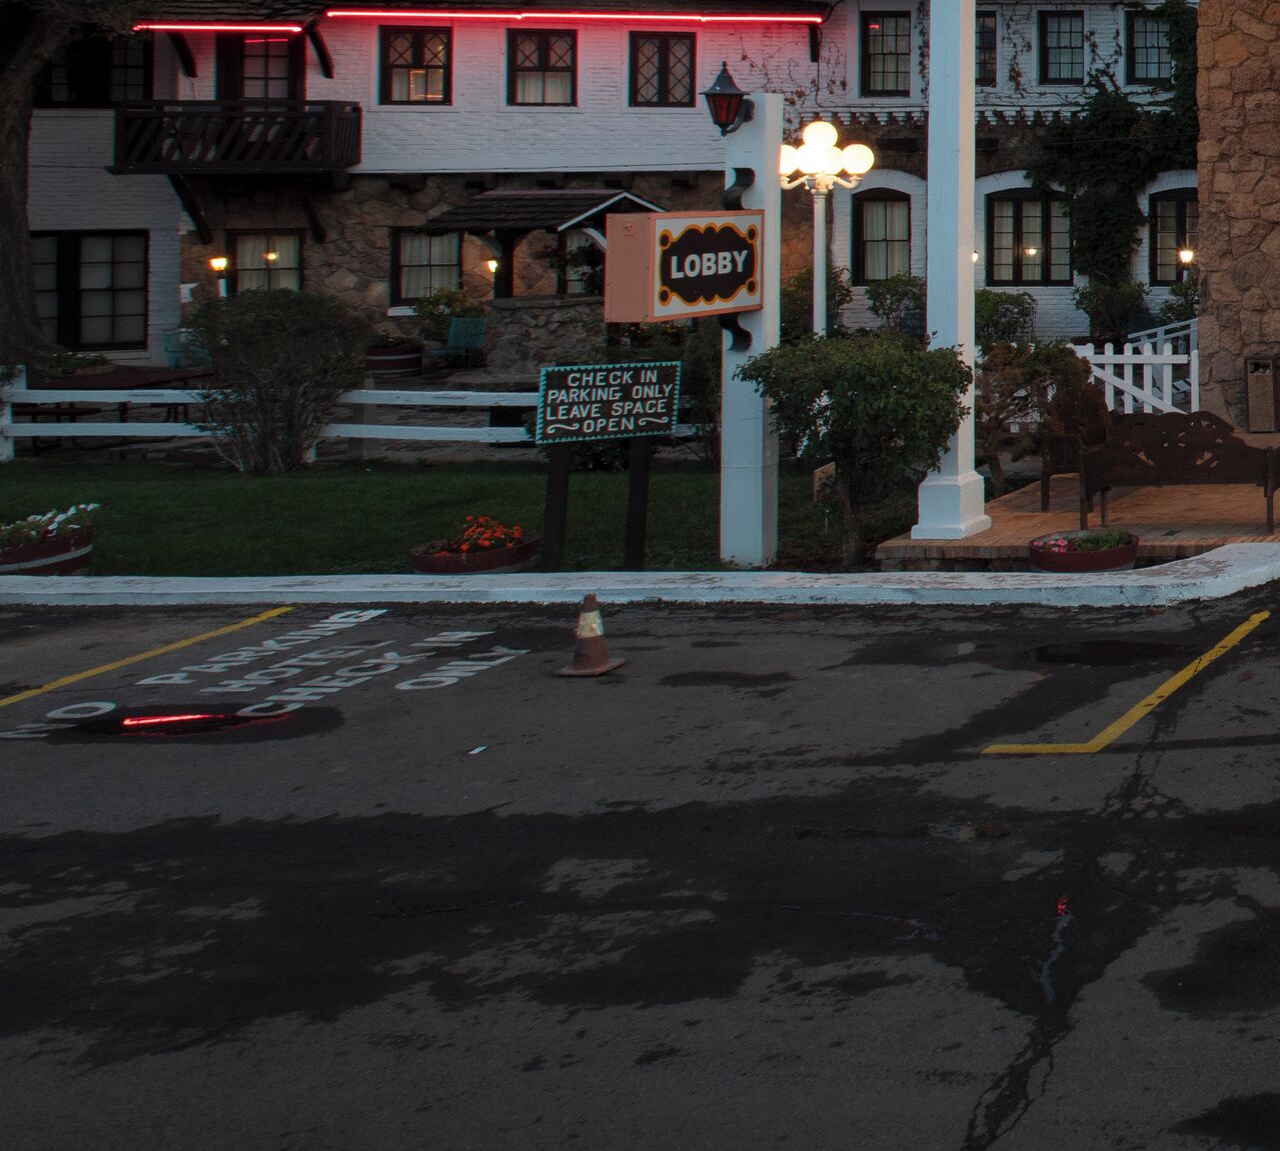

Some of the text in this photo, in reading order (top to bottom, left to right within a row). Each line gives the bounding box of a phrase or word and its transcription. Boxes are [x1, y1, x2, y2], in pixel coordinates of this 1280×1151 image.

[670, 249, 748, 279] LOBBY
[567, 370, 658, 386] CHECK IN
[547, 384, 673, 403] PARKING ONLY
[546, 399, 668, 420] LEAVE SPACE
[583, 417, 635, 432] OPEN
[135, 607, 390, 685] PARKING
[199, 640, 396, 692] HOTEL
[236, 631, 497, 717] CHECK IN
[394, 646, 533, 690] ONLY
